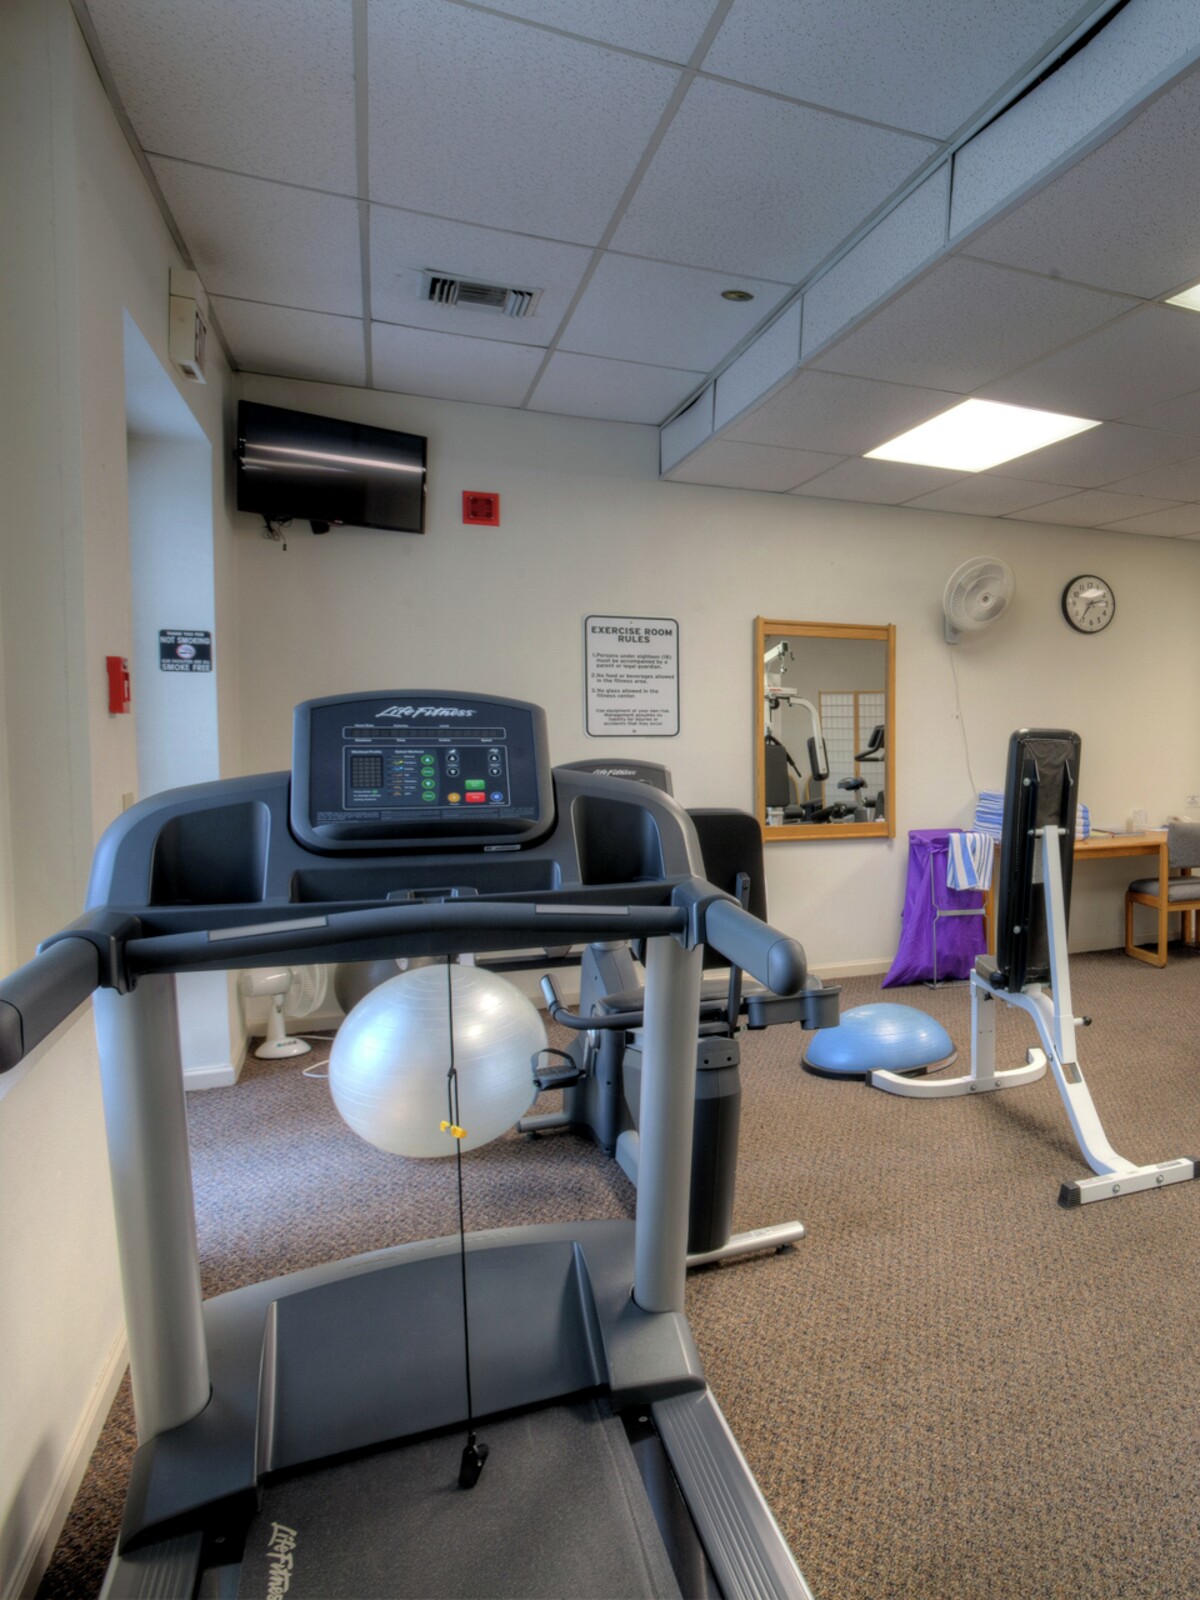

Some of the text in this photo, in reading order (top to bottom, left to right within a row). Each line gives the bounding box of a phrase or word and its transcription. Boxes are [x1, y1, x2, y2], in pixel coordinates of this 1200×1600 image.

[591, 626, 673, 636] EXERCISE ROOM
[160, 636, 210, 645] NOT SMOKING
[618, 635, 651, 643] RULES
[161, 663, 190, 671] SMOKE
